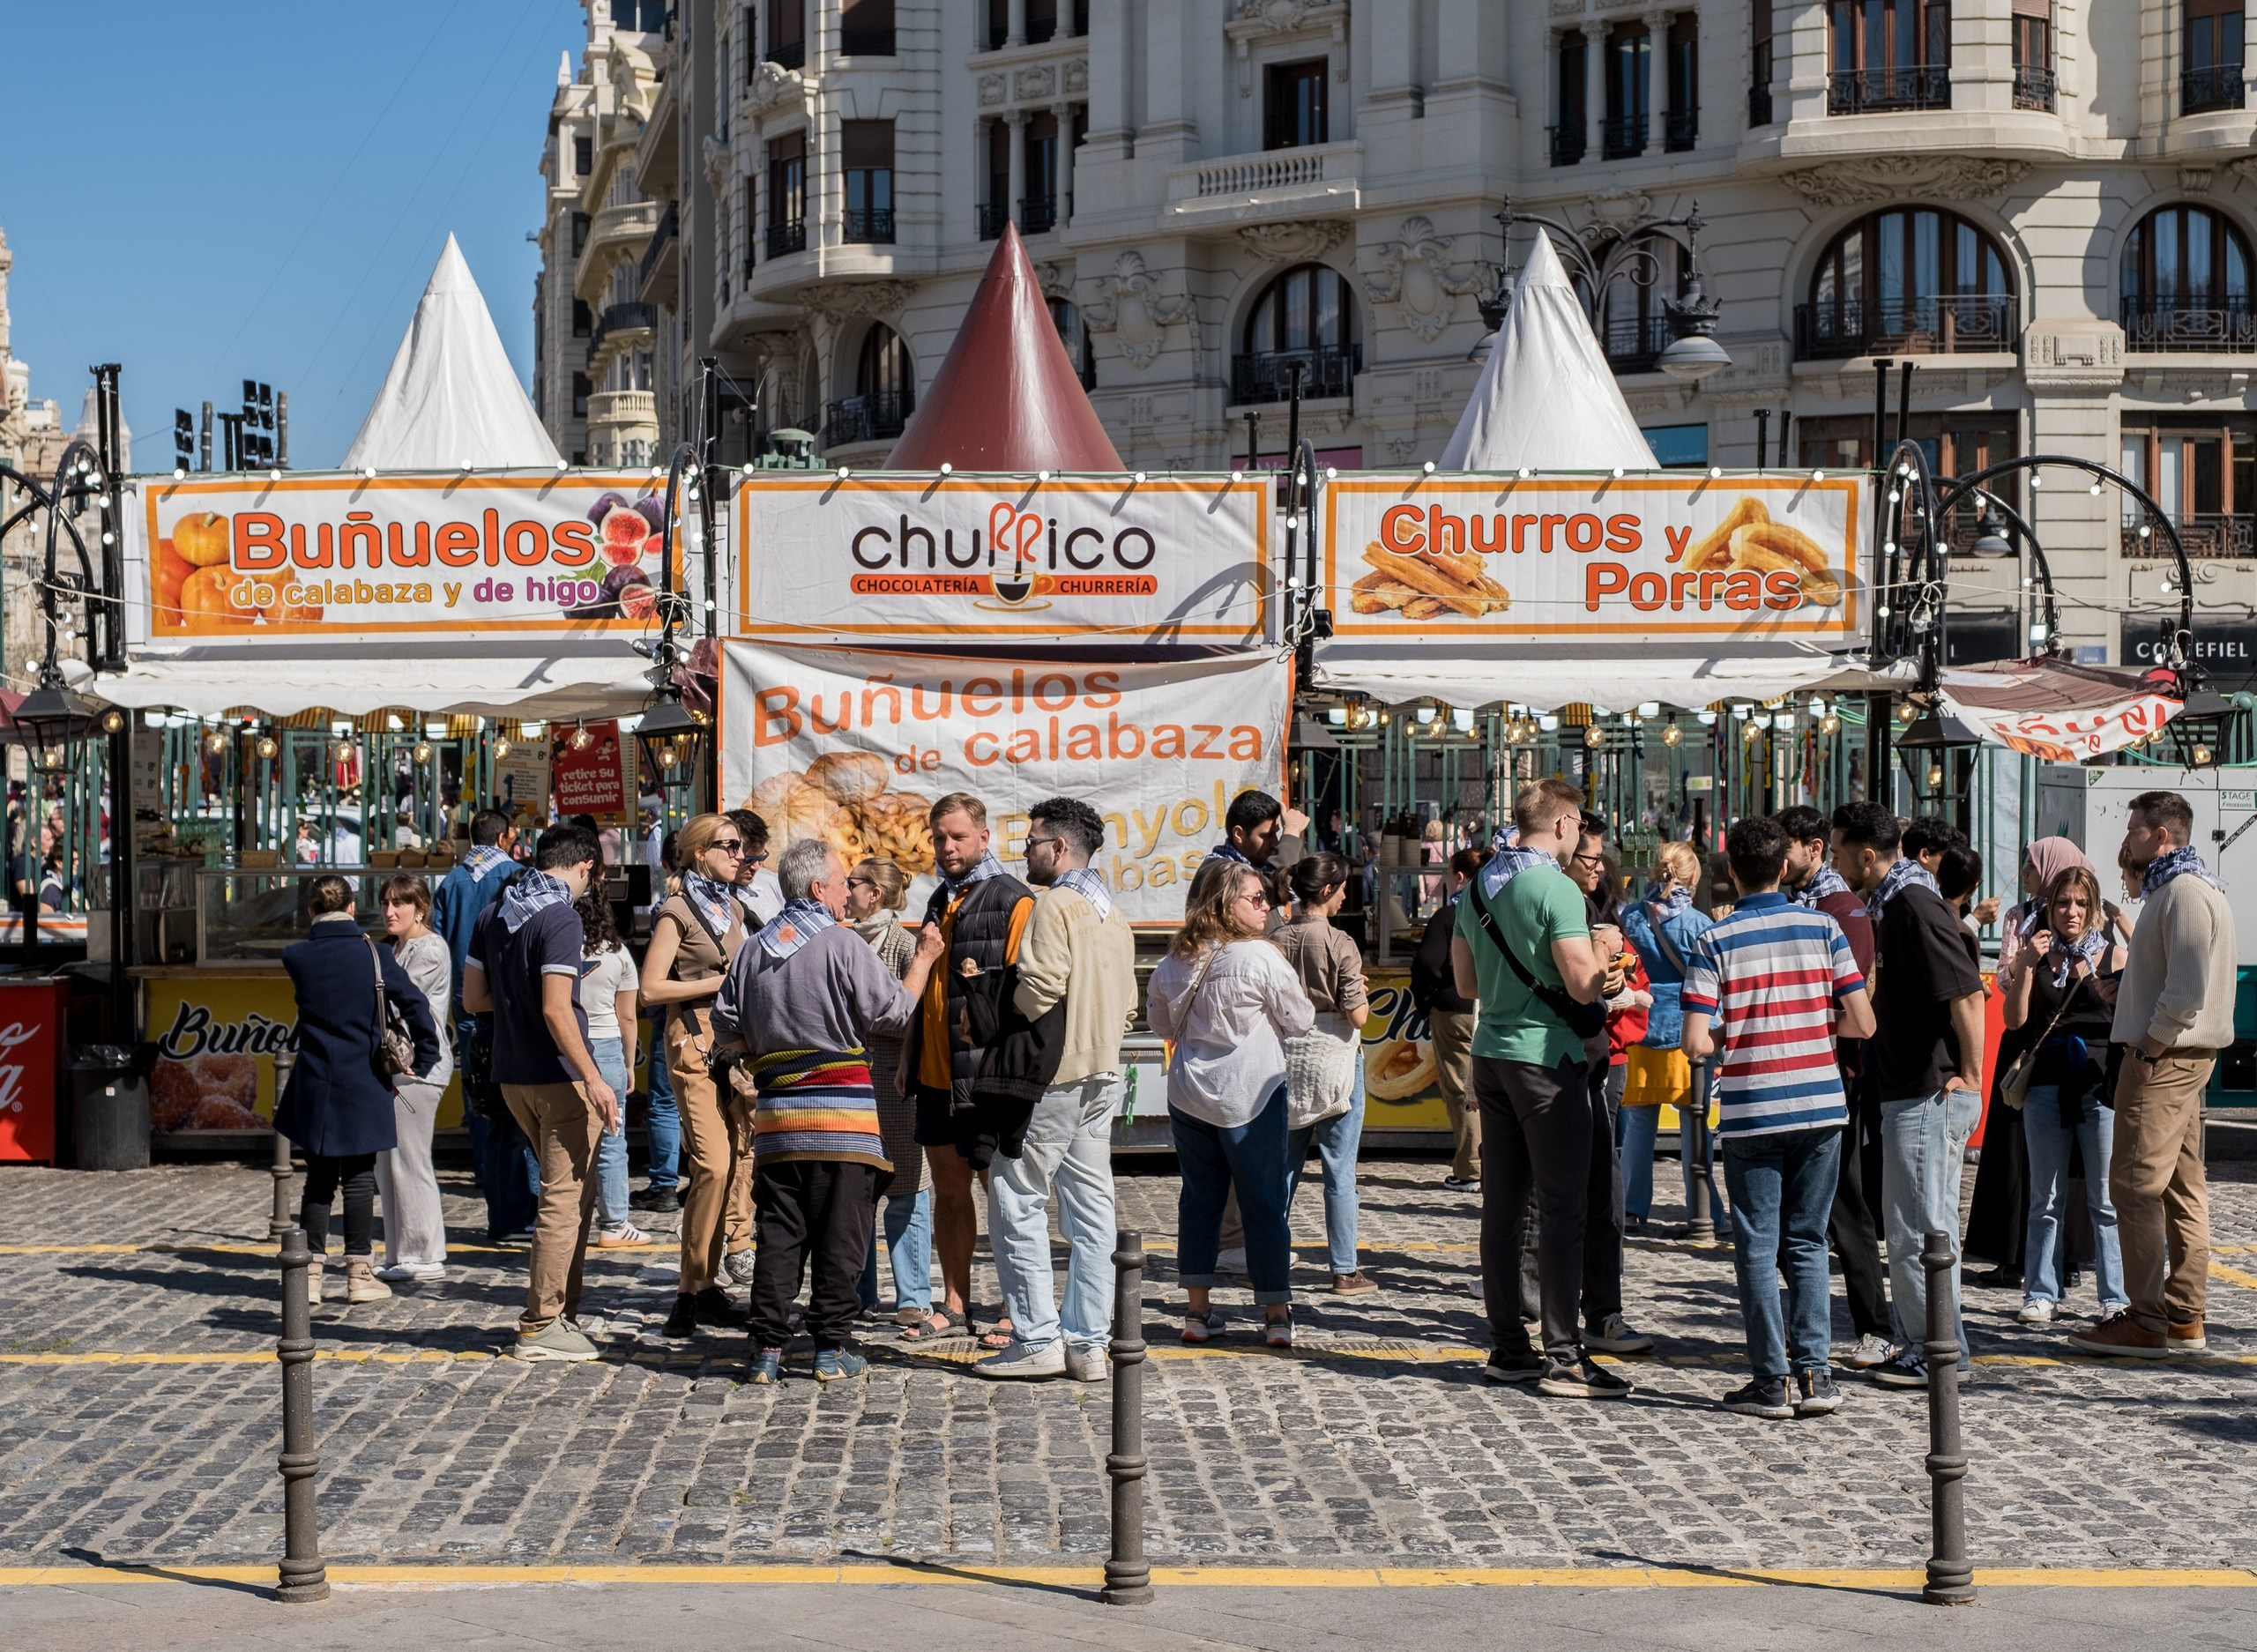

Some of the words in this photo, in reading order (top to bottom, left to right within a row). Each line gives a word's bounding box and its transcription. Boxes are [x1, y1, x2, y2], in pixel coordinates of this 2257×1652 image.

[232, 508, 597, 570] Buñuelos
[1380, 503, 1642, 554] Churros
[1665, 525, 1692, 562] y
[233, 580, 272, 606] de
[284, 579, 432, 606] calabaza
[443, 583, 460, 608] y
[473, 577, 513, 602] de
[526, 577, 598, 607] higo
[856, 575, 980, 593] CHOCOLATERÍA
[1059, 577, 1152, 594] CHURRERÍA
[1585, 562, 1802, 612] Porras
[754, 668, 1122, 748] Buñuelos
[894, 744, 942, 776] de
[964, 711, 1263, 767] calabaza
[558, 780, 594, 793] ticket
[596, 780, 620, 792] para
[562, 768, 597, 781] retire
[562, 793, 619, 806] consumir
[2221, 791, 2251, 800] STAGE
